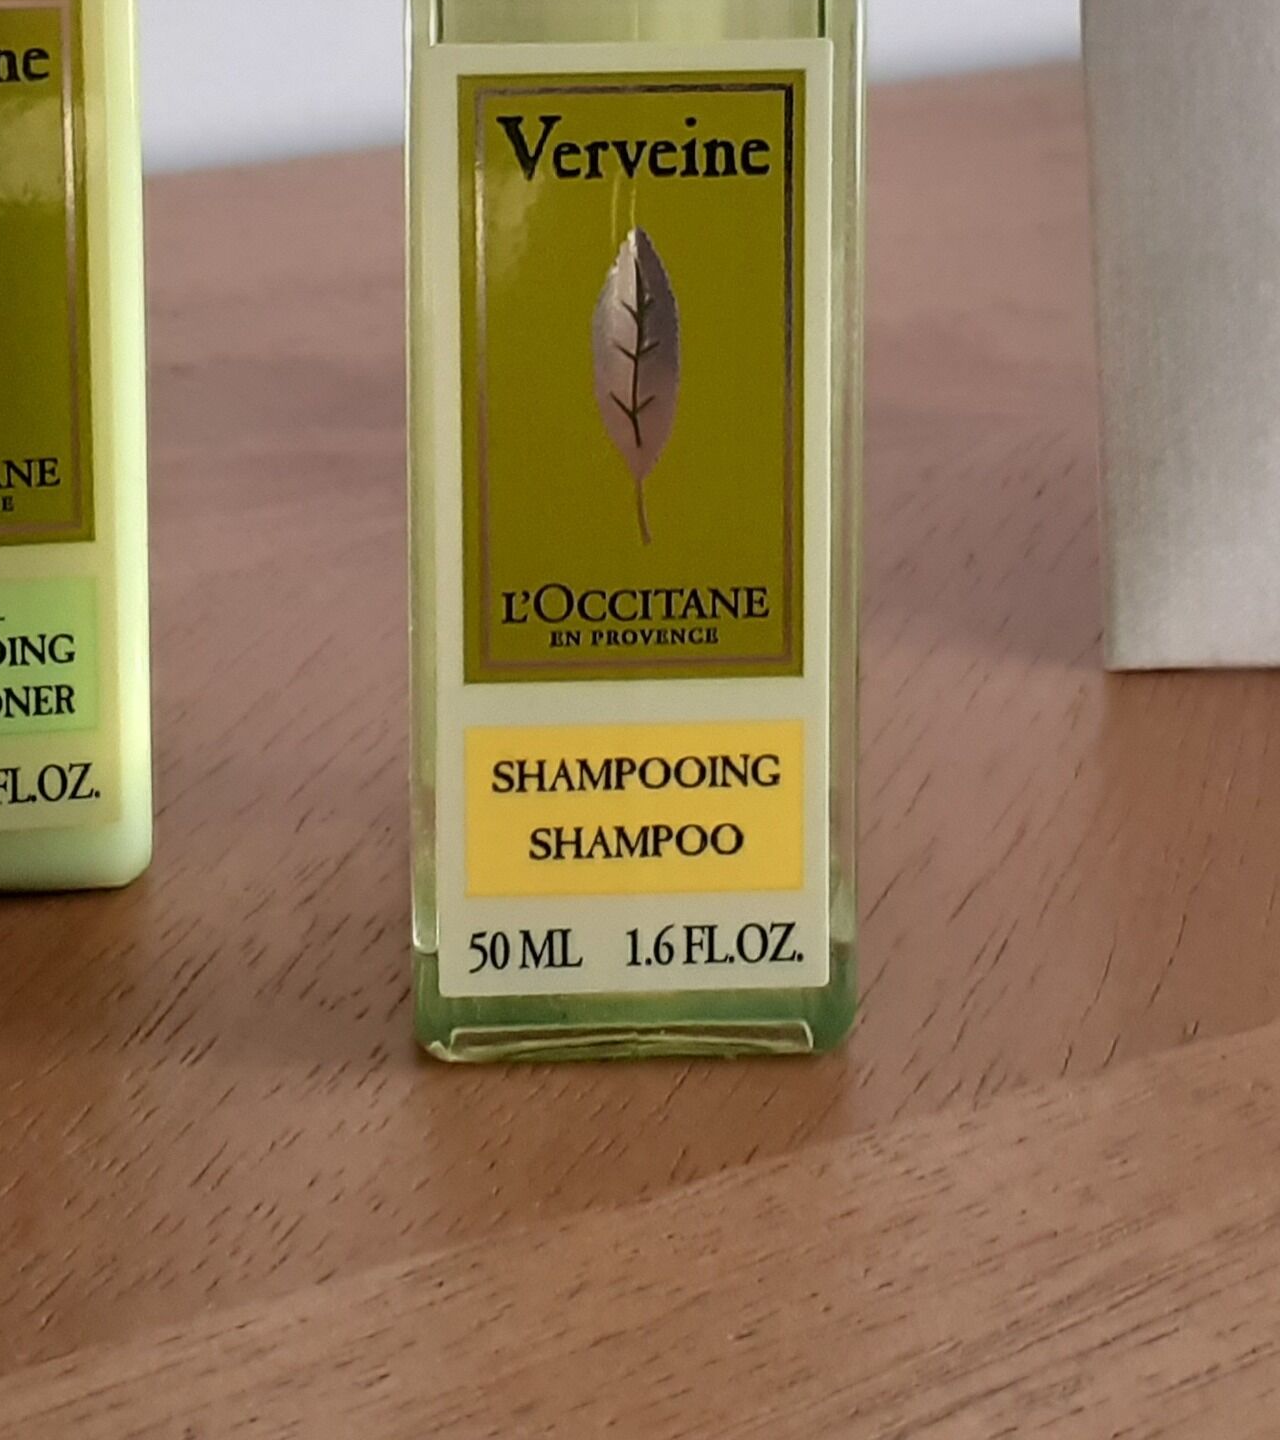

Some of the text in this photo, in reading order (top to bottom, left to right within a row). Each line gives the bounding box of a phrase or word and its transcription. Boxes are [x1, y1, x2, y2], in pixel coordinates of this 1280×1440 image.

[496, 115, 771, 181] Verveine
[500, 583, 771, 625] L'OCCITANE
[549, 627, 719, 648] EN PROVENCE
[491, 753, 781, 794] SHAMPOOING
[529, 822, 745, 862] SHAMPOO
[468, 930, 510, 974] 50
[518, 927, 583, 970] ML
[625, 924, 675, 967] 1.6
